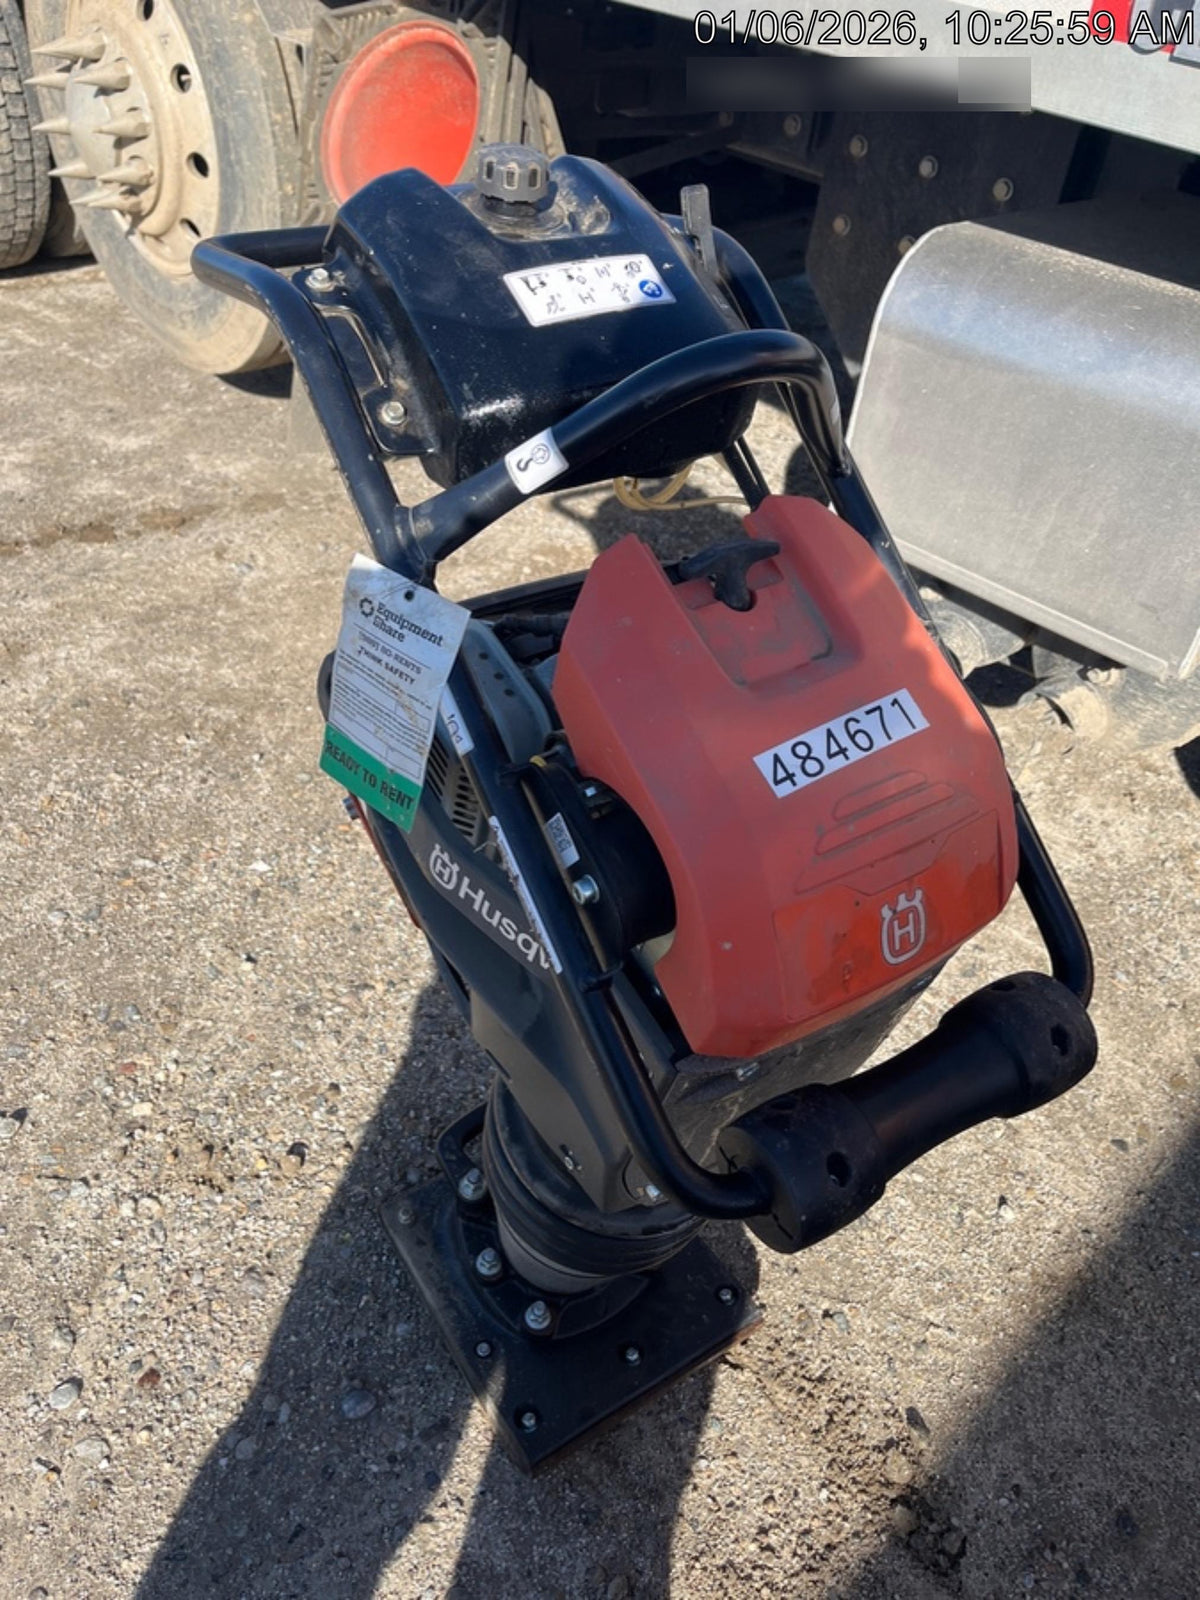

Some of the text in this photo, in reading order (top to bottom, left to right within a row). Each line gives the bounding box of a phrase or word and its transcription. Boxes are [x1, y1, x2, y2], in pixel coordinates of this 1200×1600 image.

[372, 615, 406, 643] Share
[376, 602, 443, 647] Equipment
[384, 662, 415, 685] SAFETY
[771, 697, 916, 787] 484671
[324, 741, 414, 811] READY TO RENT
